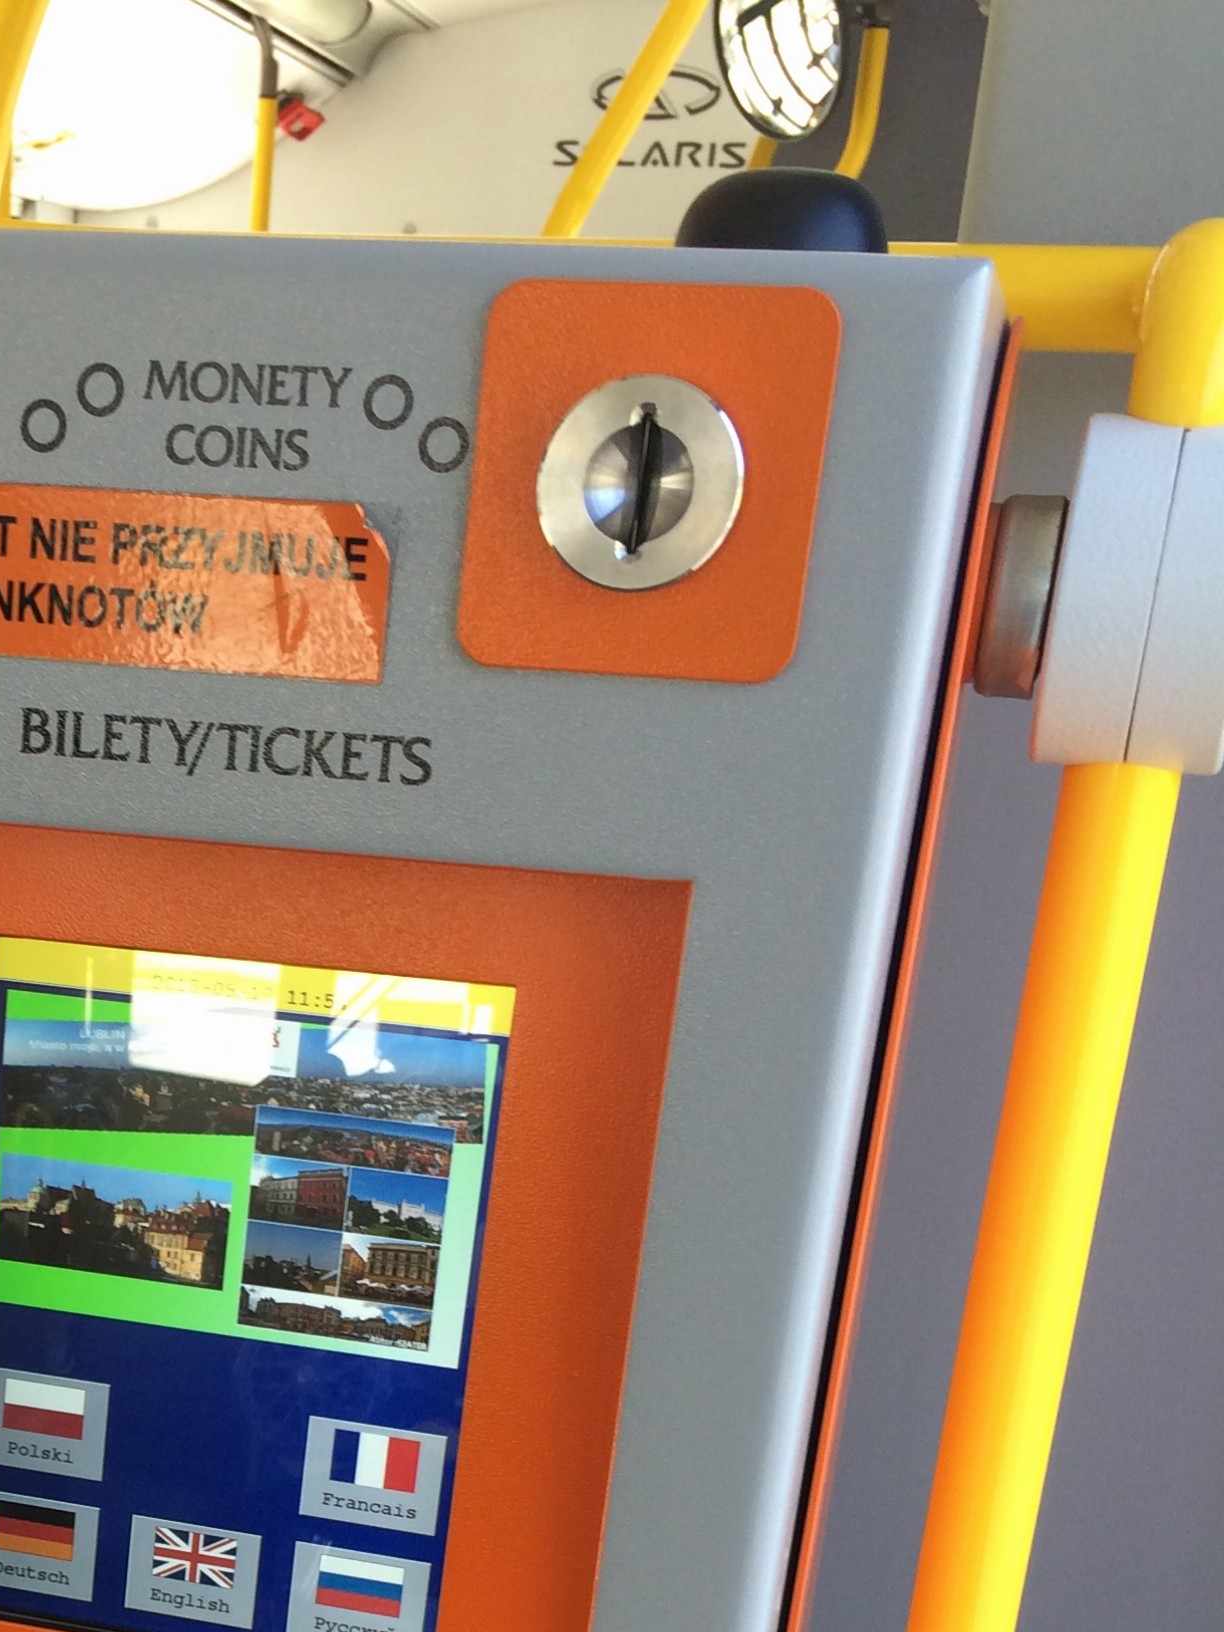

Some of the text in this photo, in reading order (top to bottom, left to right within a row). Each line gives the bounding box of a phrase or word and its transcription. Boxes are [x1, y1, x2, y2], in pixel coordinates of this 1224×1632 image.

[553, 140, 748, 169] SARIS
[144, 359, 353, 409] MONETY
[165, 424, 310, 471] COINS
[29, 518, 98, 564] NIE
[111, 522, 368, 583] PRZYJMUJE
[19, 707, 434, 787] BILETY/TICKETS
[7, 1440, 74, 1465] Polski
[321, 1491, 417, 1521] Francais
[149, 1587, 231, 1615] English
